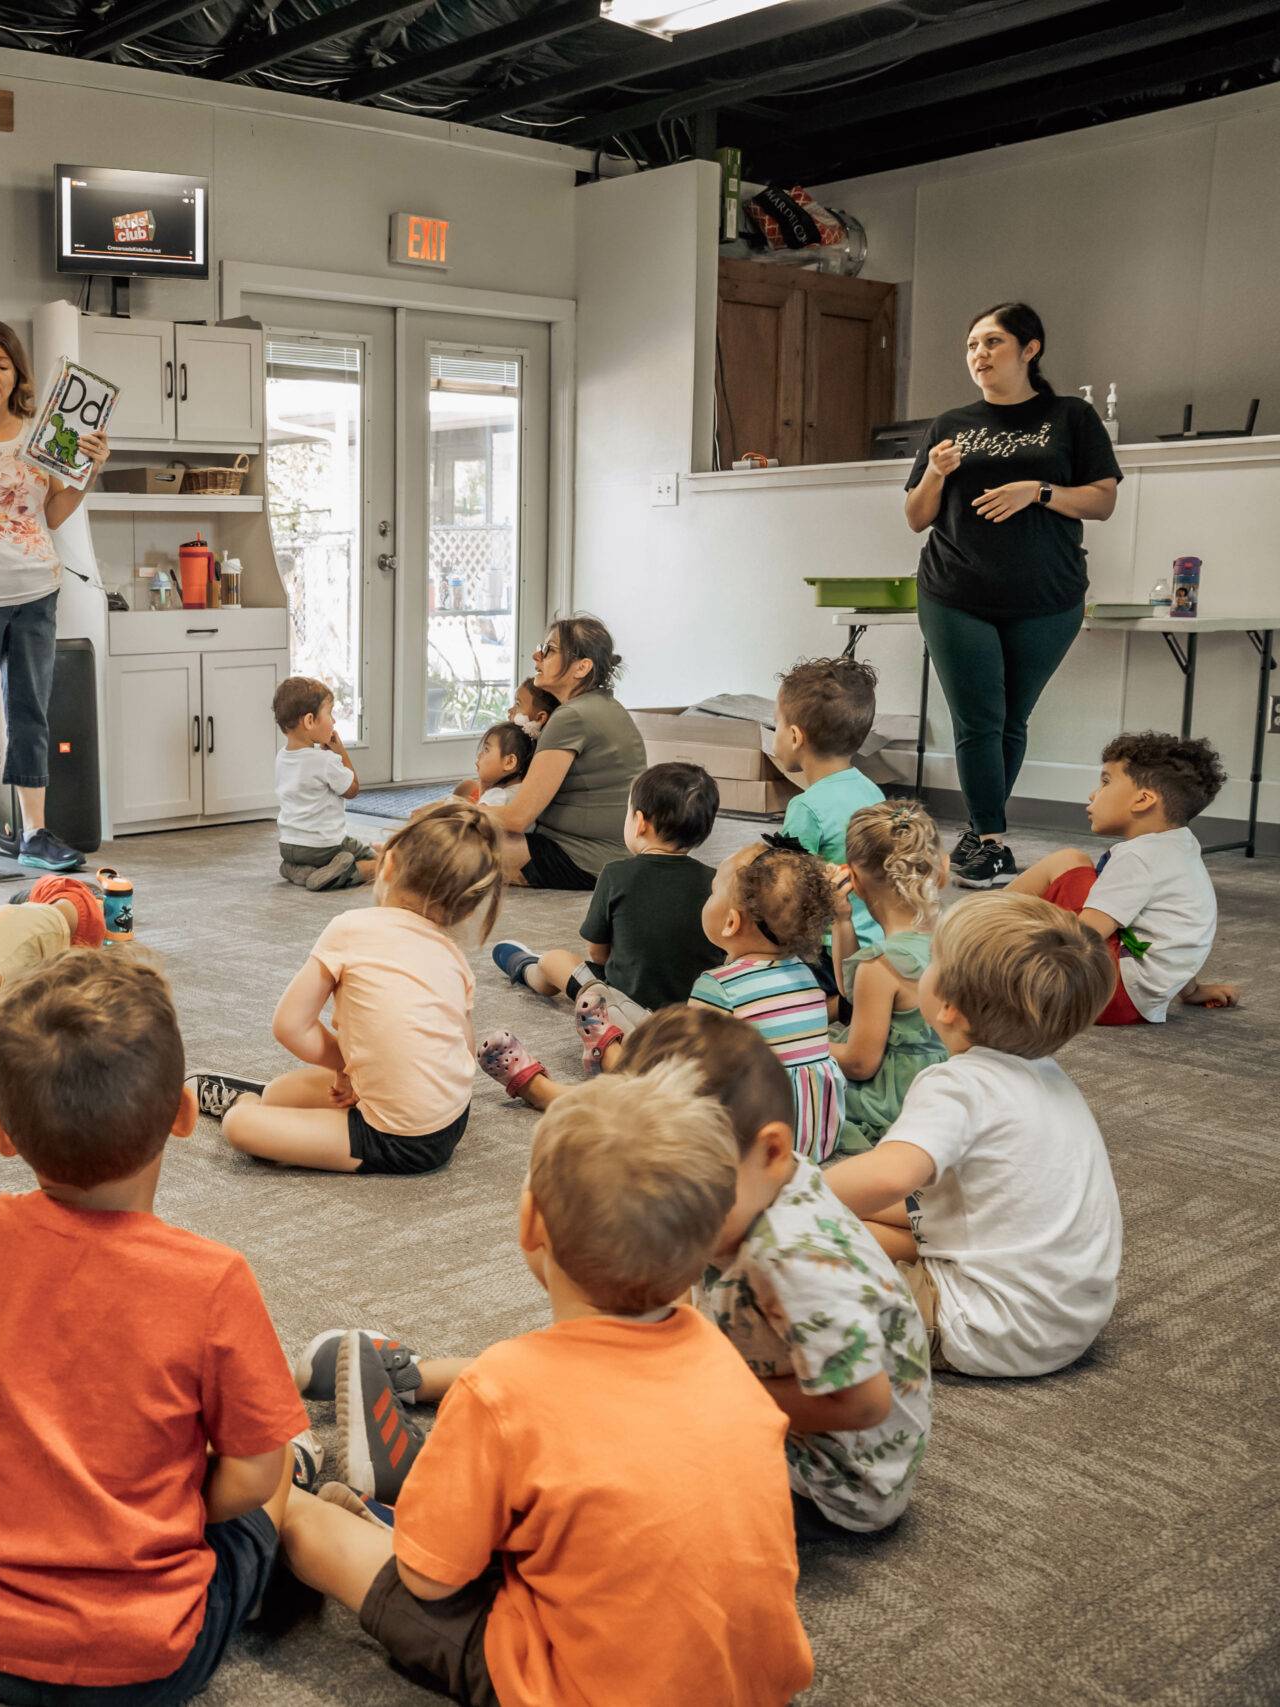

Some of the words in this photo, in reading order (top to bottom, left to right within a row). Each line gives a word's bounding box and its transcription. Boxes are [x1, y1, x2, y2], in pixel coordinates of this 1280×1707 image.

[117, 226, 148, 242] club
[407, 216, 449, 262] EXIT
[58, 373, 109, 430] Dd
[955, 422, 1053, 458] Blessed
